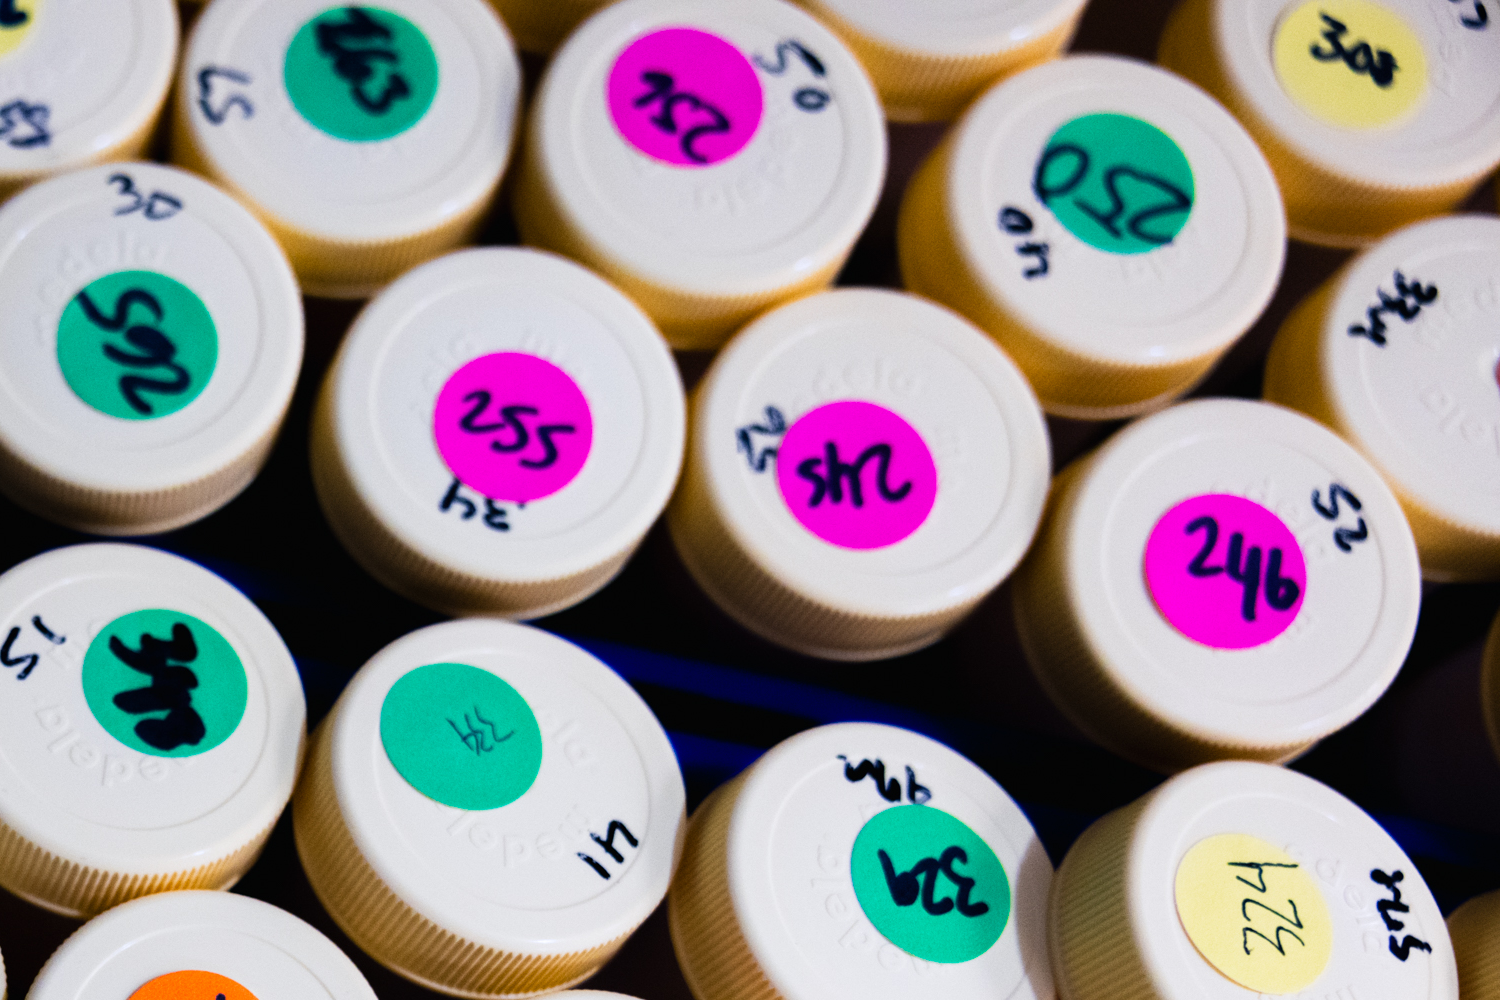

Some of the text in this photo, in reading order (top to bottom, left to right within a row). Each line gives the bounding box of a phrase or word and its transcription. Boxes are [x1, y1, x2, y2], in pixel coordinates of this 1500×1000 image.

[1031, 142, 1192, 247] 250
[460, 390, 576, 470] 255
[796, 442, 912, 508] 245
[1185, 518, 1300, 620] 246
[878, 845, 990, 920] 329
[1226, 856, 1306, 960] 324
